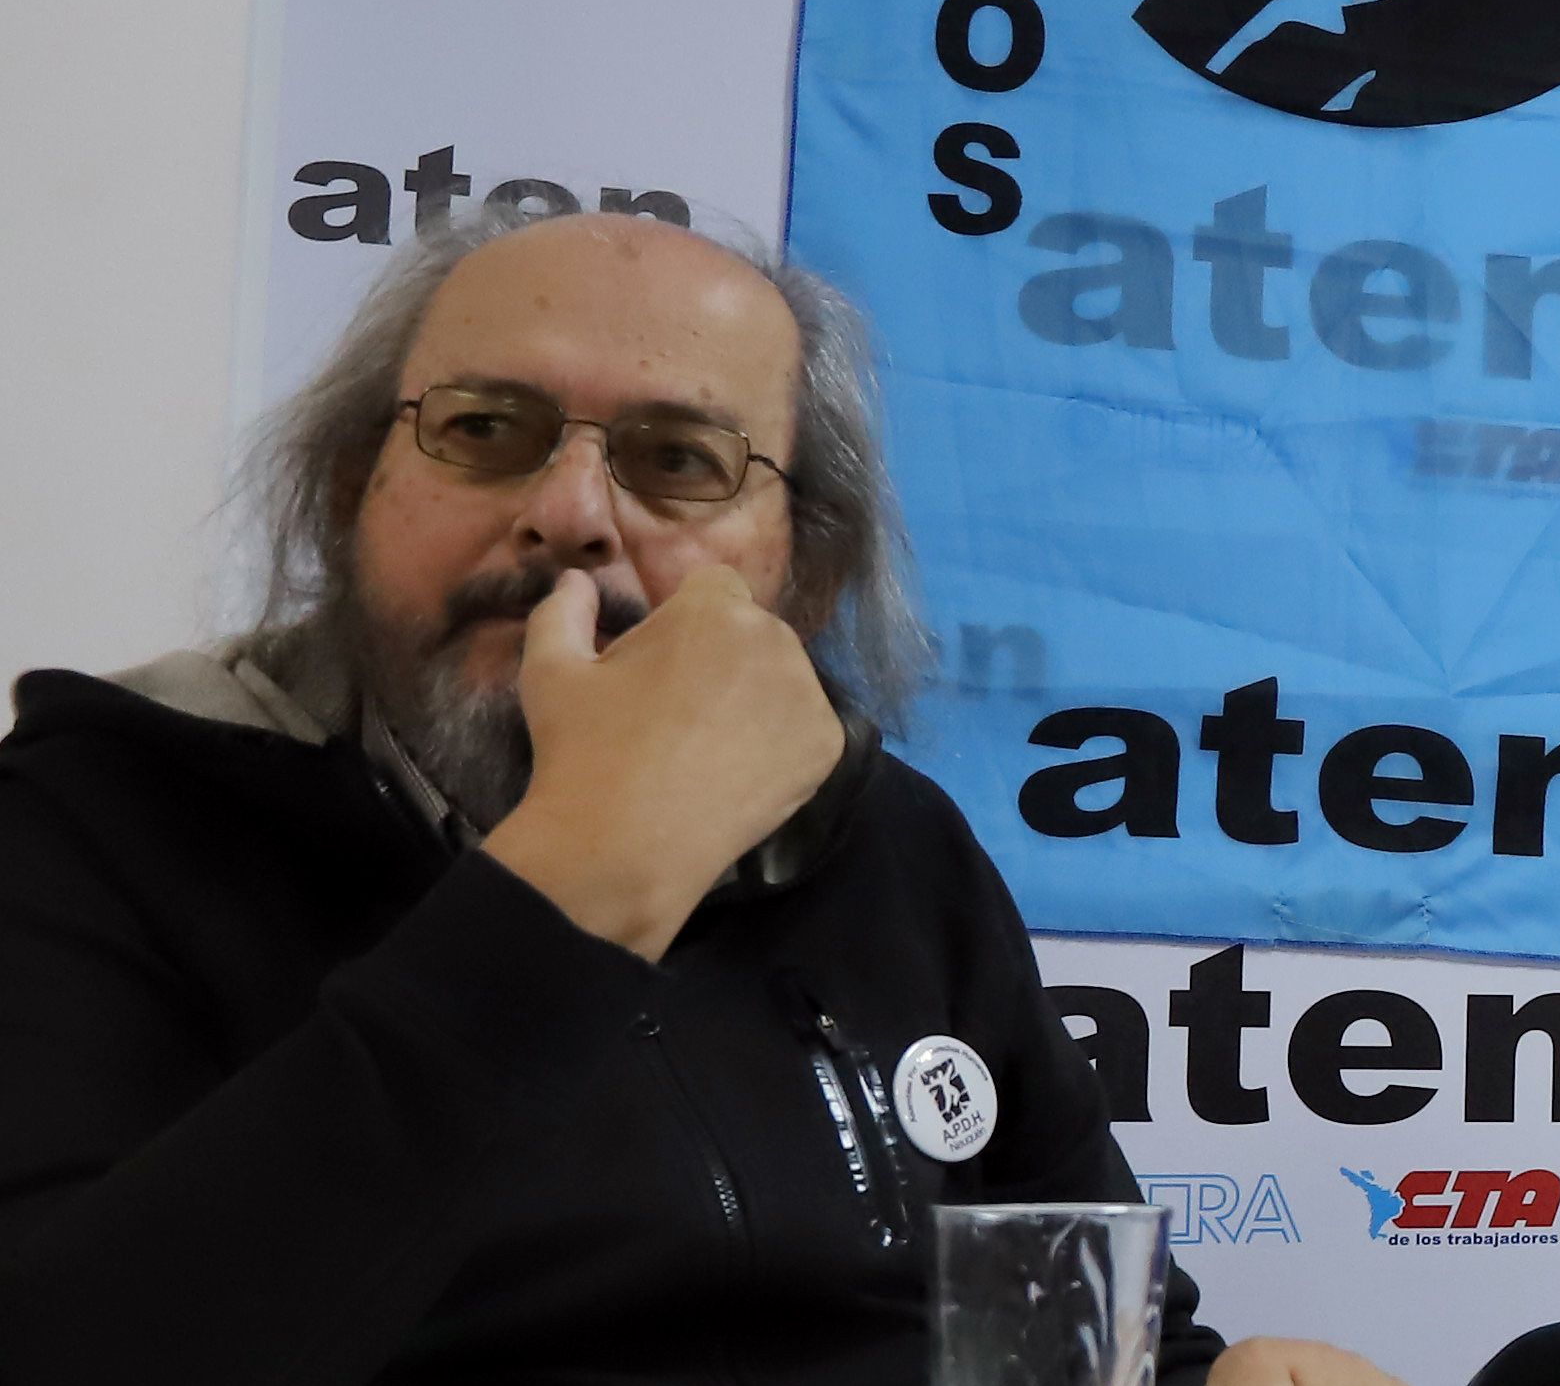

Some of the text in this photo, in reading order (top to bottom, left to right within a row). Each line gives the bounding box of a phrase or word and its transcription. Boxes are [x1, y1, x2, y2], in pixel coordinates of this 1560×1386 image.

[1388, 1232, 1558, 1247] de los trabajadores
